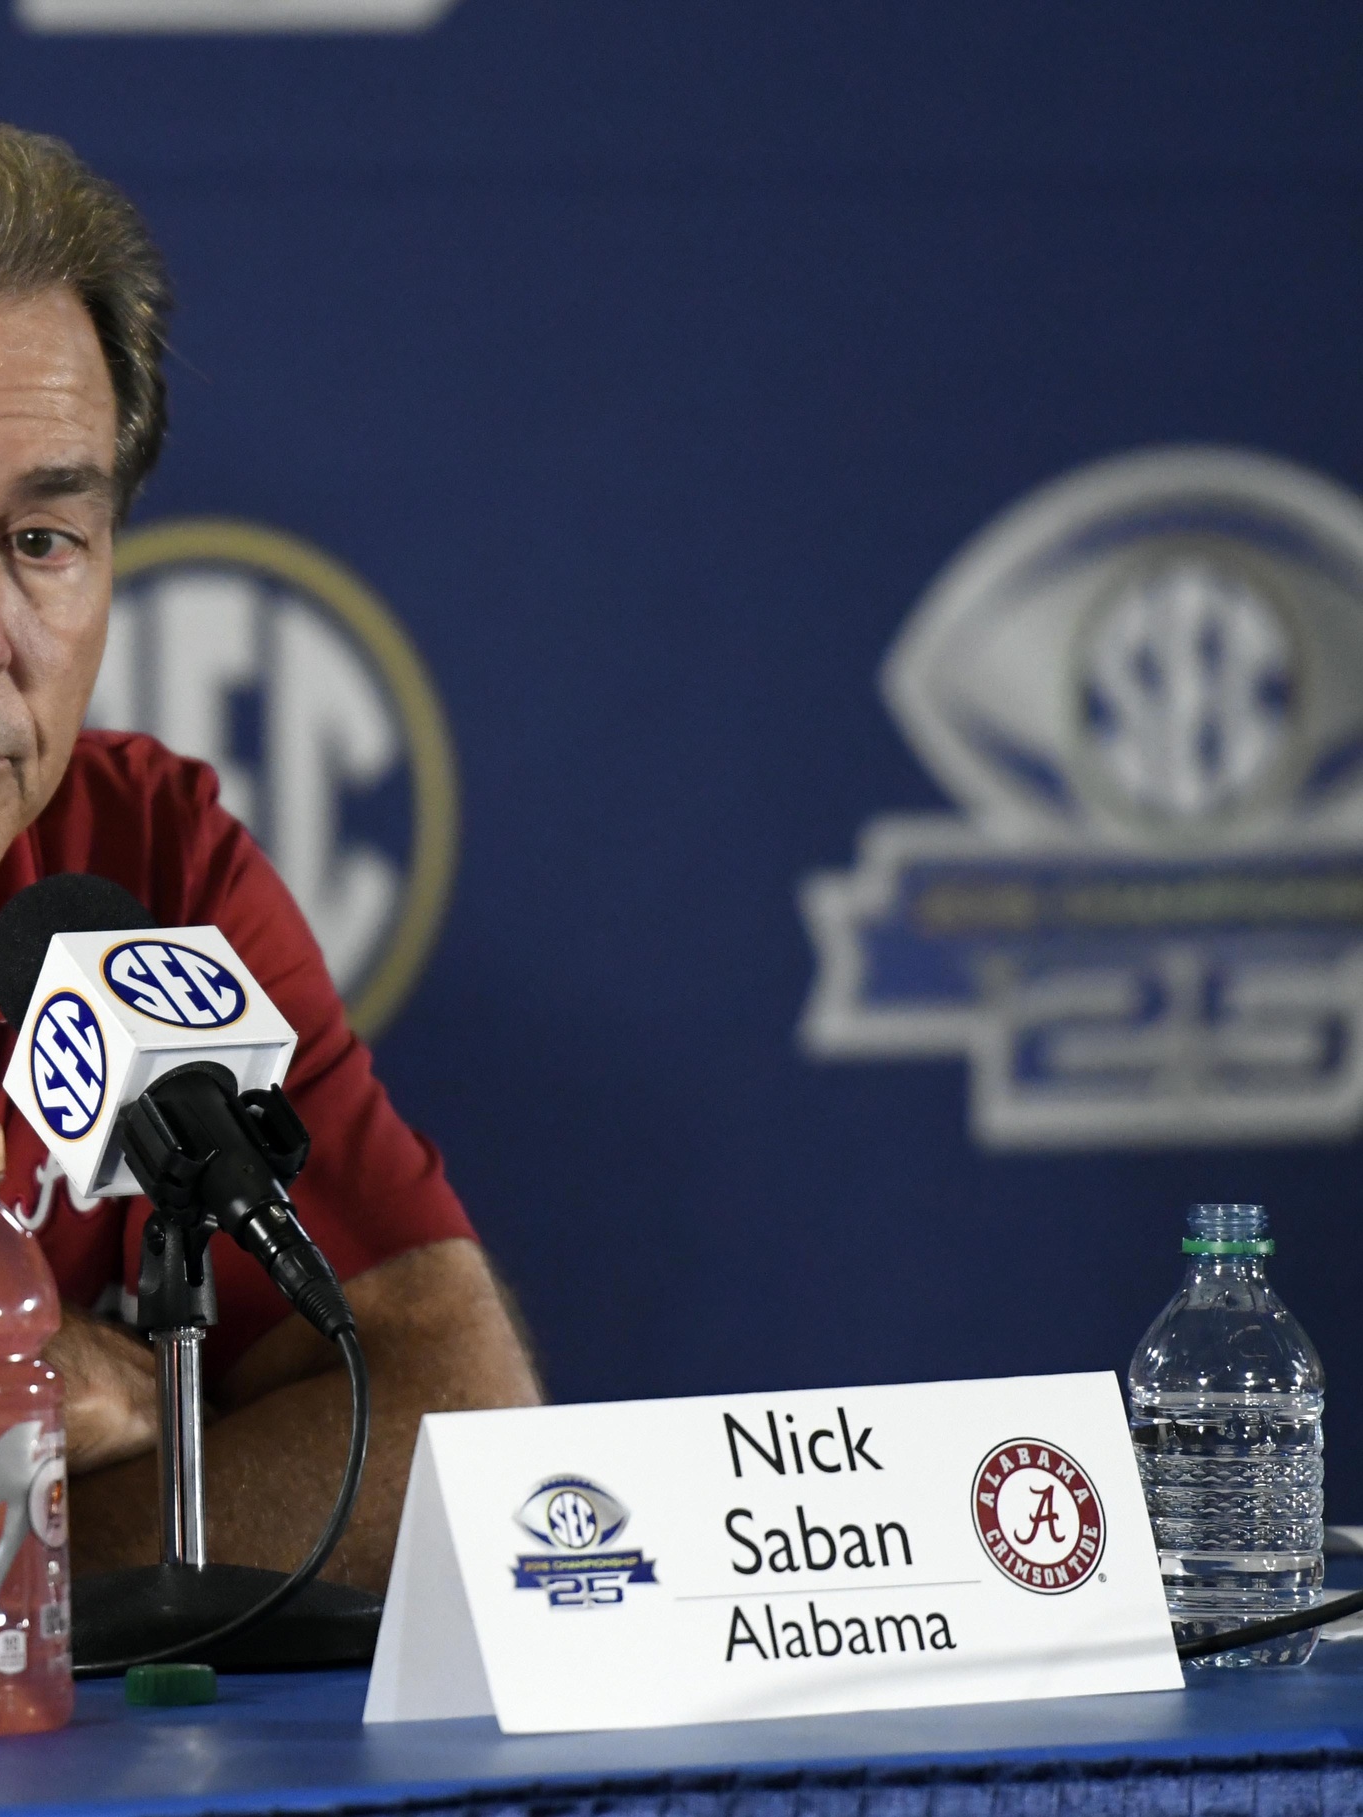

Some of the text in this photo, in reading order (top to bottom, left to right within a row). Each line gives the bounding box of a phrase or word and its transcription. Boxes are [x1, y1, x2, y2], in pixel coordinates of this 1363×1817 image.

[1082, 570, 1297, 808] SEC
[109, 943, 239, 1026] SEC
[34, 999, 104, 1133] SEC
[723, 1406, 885, 1478] Nick
[979, 1446, 1091, 1509] ALABAMA
[548, 1492, 597, 1548] SEC
[724, 1505, 913, 1575] Saban
[1013, 1484, 1066, 1545] A
[985, 1523, 1099, 1587] CRIMSON TIDE
[547, 1575, 625, 1607] 25
[725, 1601, 958, 1662] Alabama
